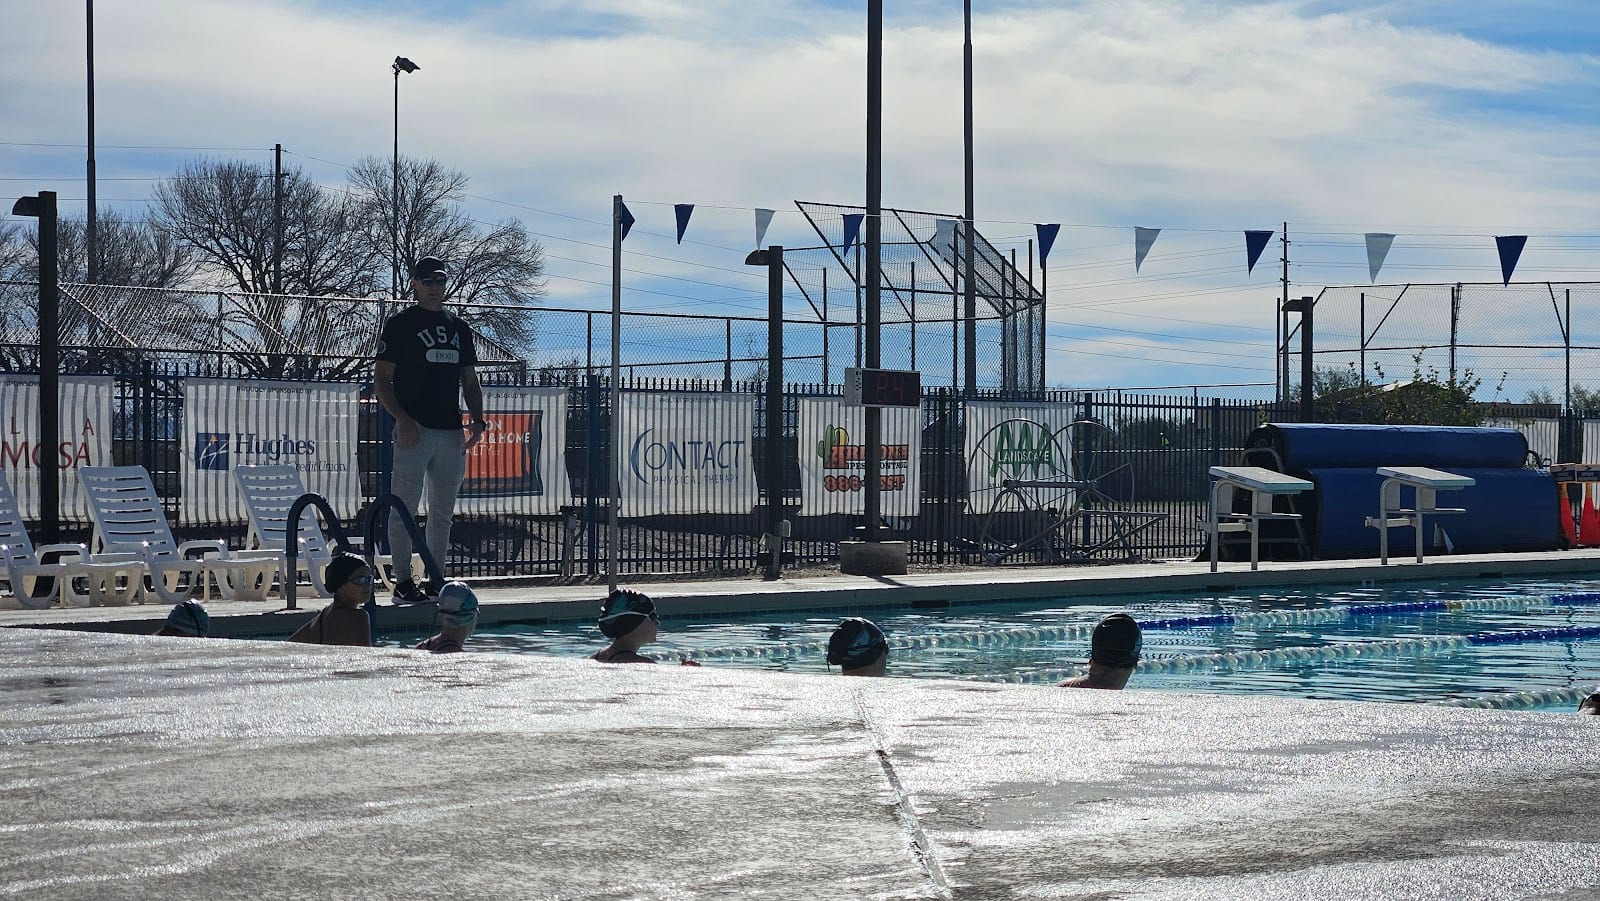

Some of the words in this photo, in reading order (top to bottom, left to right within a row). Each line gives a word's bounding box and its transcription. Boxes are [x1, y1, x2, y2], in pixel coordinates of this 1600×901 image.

[417, 326, 461, 350] USA
[233, 433, 315, 460] Hughes
[498, 432, 530, 443] HOME
[989, 422, 1057, 478] AAA
[630, 427, 745, 486] CONTACT
